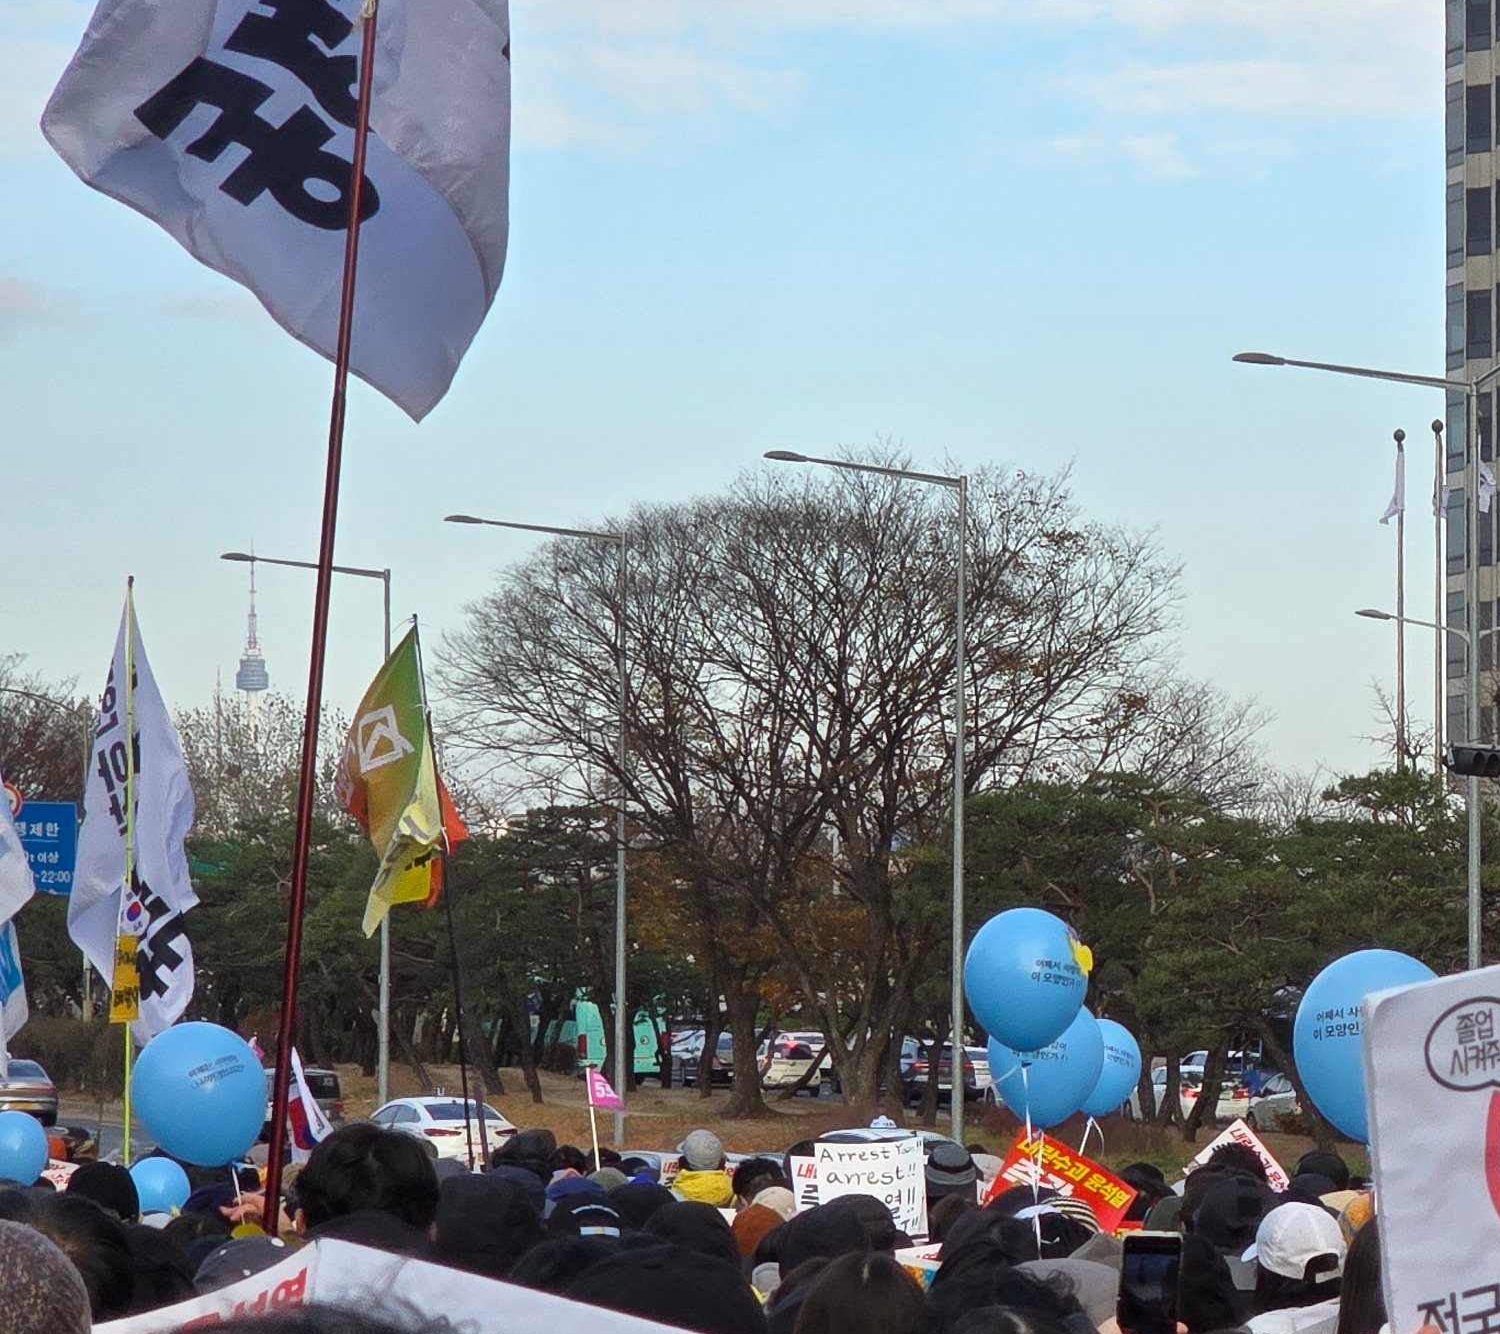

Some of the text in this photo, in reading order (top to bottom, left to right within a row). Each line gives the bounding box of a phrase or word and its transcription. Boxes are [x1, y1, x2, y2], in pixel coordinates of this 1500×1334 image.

[1313, 1022, 1362, 1040] 이 모양인
[1455, 1007, 1494, 1046] 졸업
[820, 1148, 891, 1163] Arrest
[826, 1163, 916, 1185] arrest!!
[1083, 1173, 1131, 1209] 윤석열
